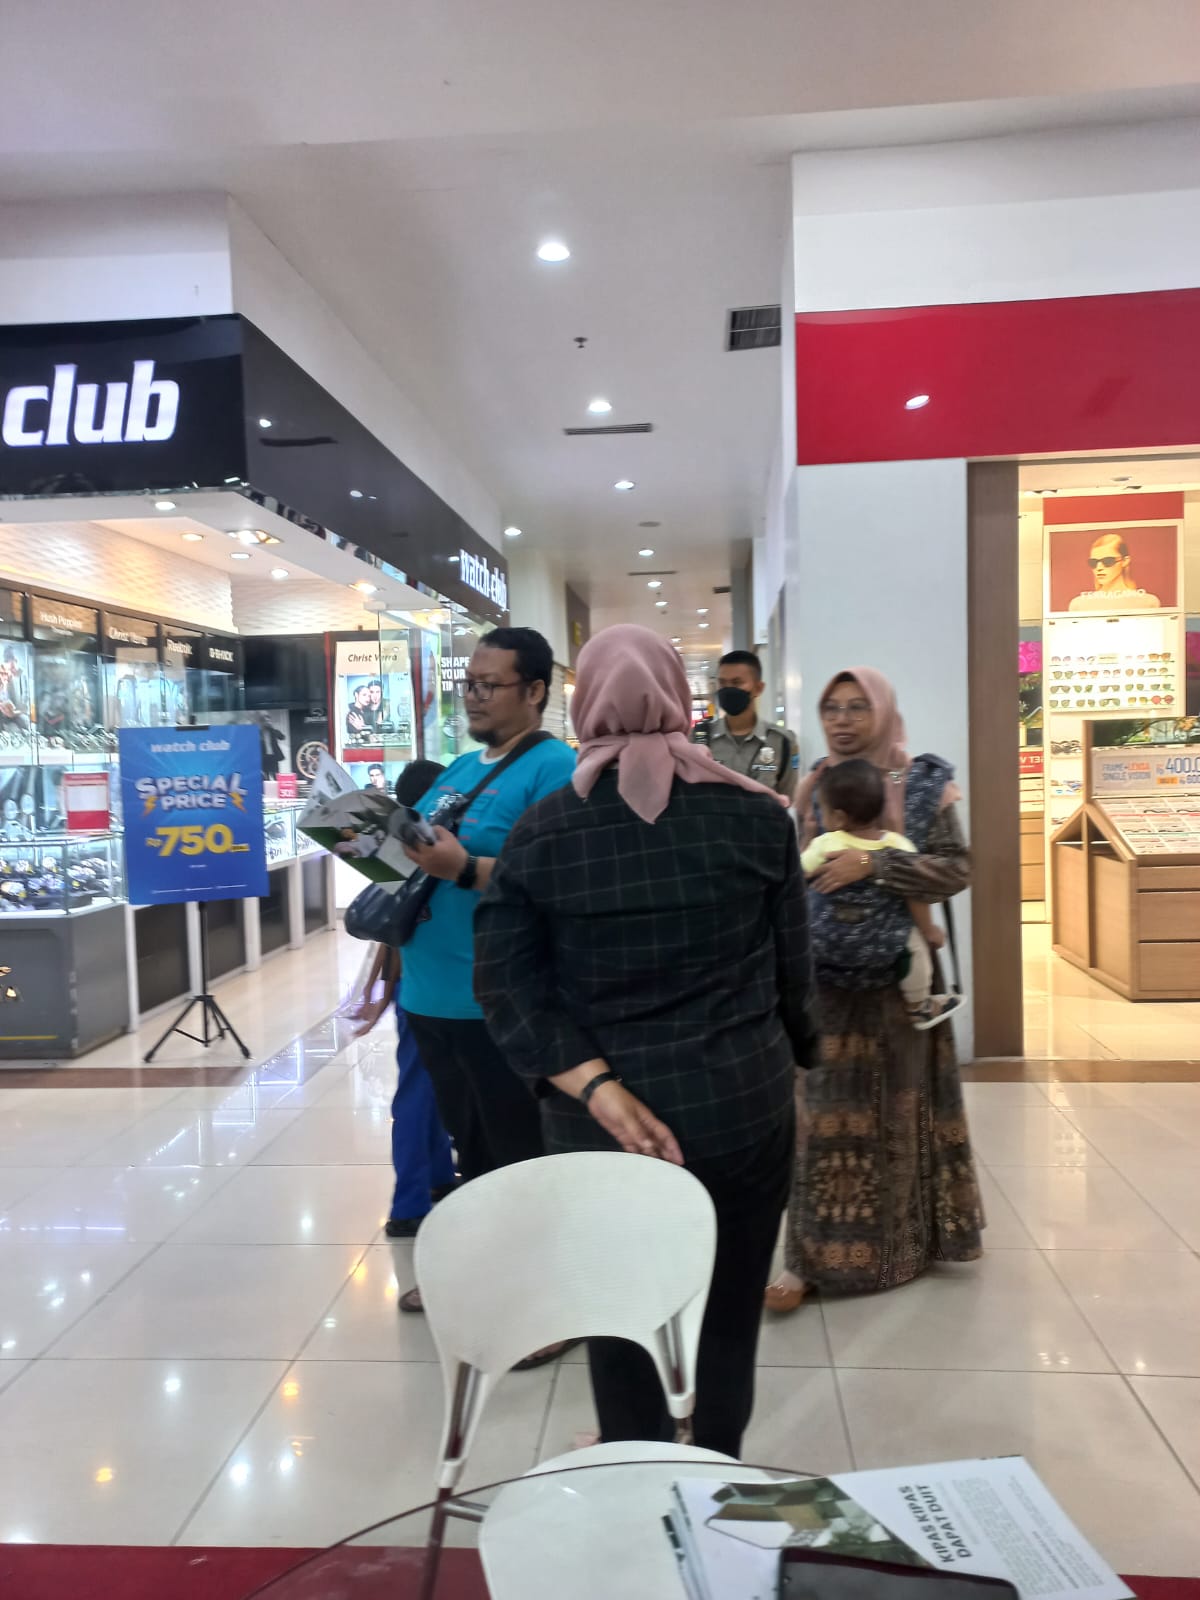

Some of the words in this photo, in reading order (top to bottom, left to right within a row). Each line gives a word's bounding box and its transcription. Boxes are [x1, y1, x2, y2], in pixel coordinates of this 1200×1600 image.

[2, 360, 180, 447] club
[347, 653, 372, 662] Christ
[441, 657, 470, 668] SHAPE
[441, 669, 466, 679] YOUR
[151, 741, 196, 753] watch
[199, 740, 231, 752] club
[135, 772, 248, 800] SPECIAL
[161, 793, 227, 811] PRICE
[155, 823, 234, 857] 750
[898, 1485, 930, 1523] KIPAS
[914, 1484, 944, 1513] DUIT
[920, 1525, 956, 1563] KIPAS
[934, 1515, 973, 1559] DAPAT
